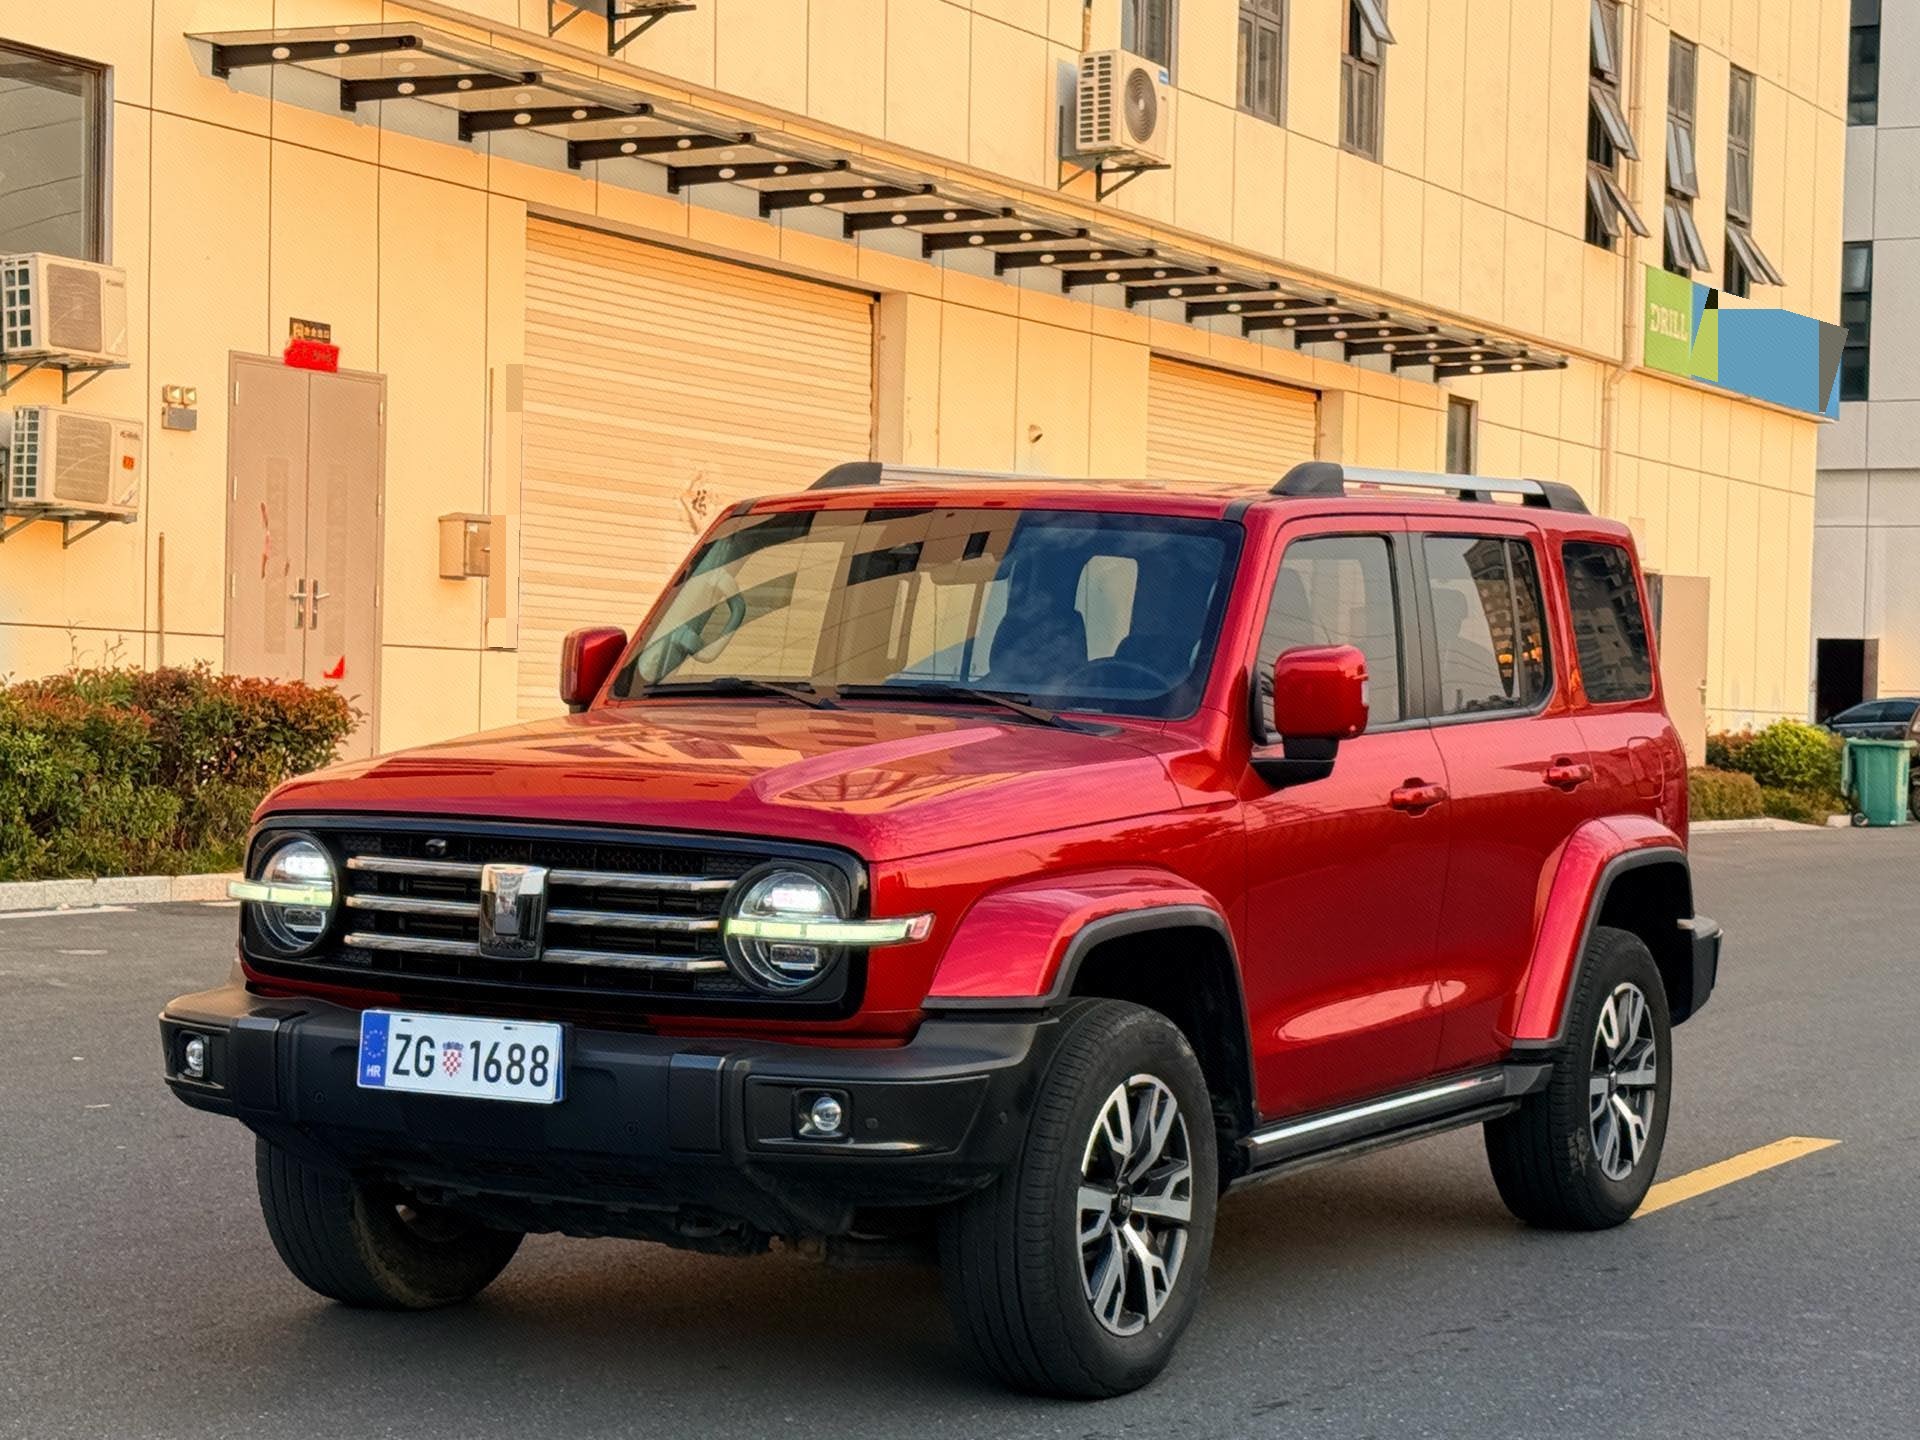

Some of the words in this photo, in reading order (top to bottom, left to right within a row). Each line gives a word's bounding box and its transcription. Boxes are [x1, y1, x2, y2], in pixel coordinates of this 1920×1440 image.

[366, 1063, 381, 1078] HR
[392, 1033, 436, 1078] ZG
[469, 1040, 550, 1087] 1688
